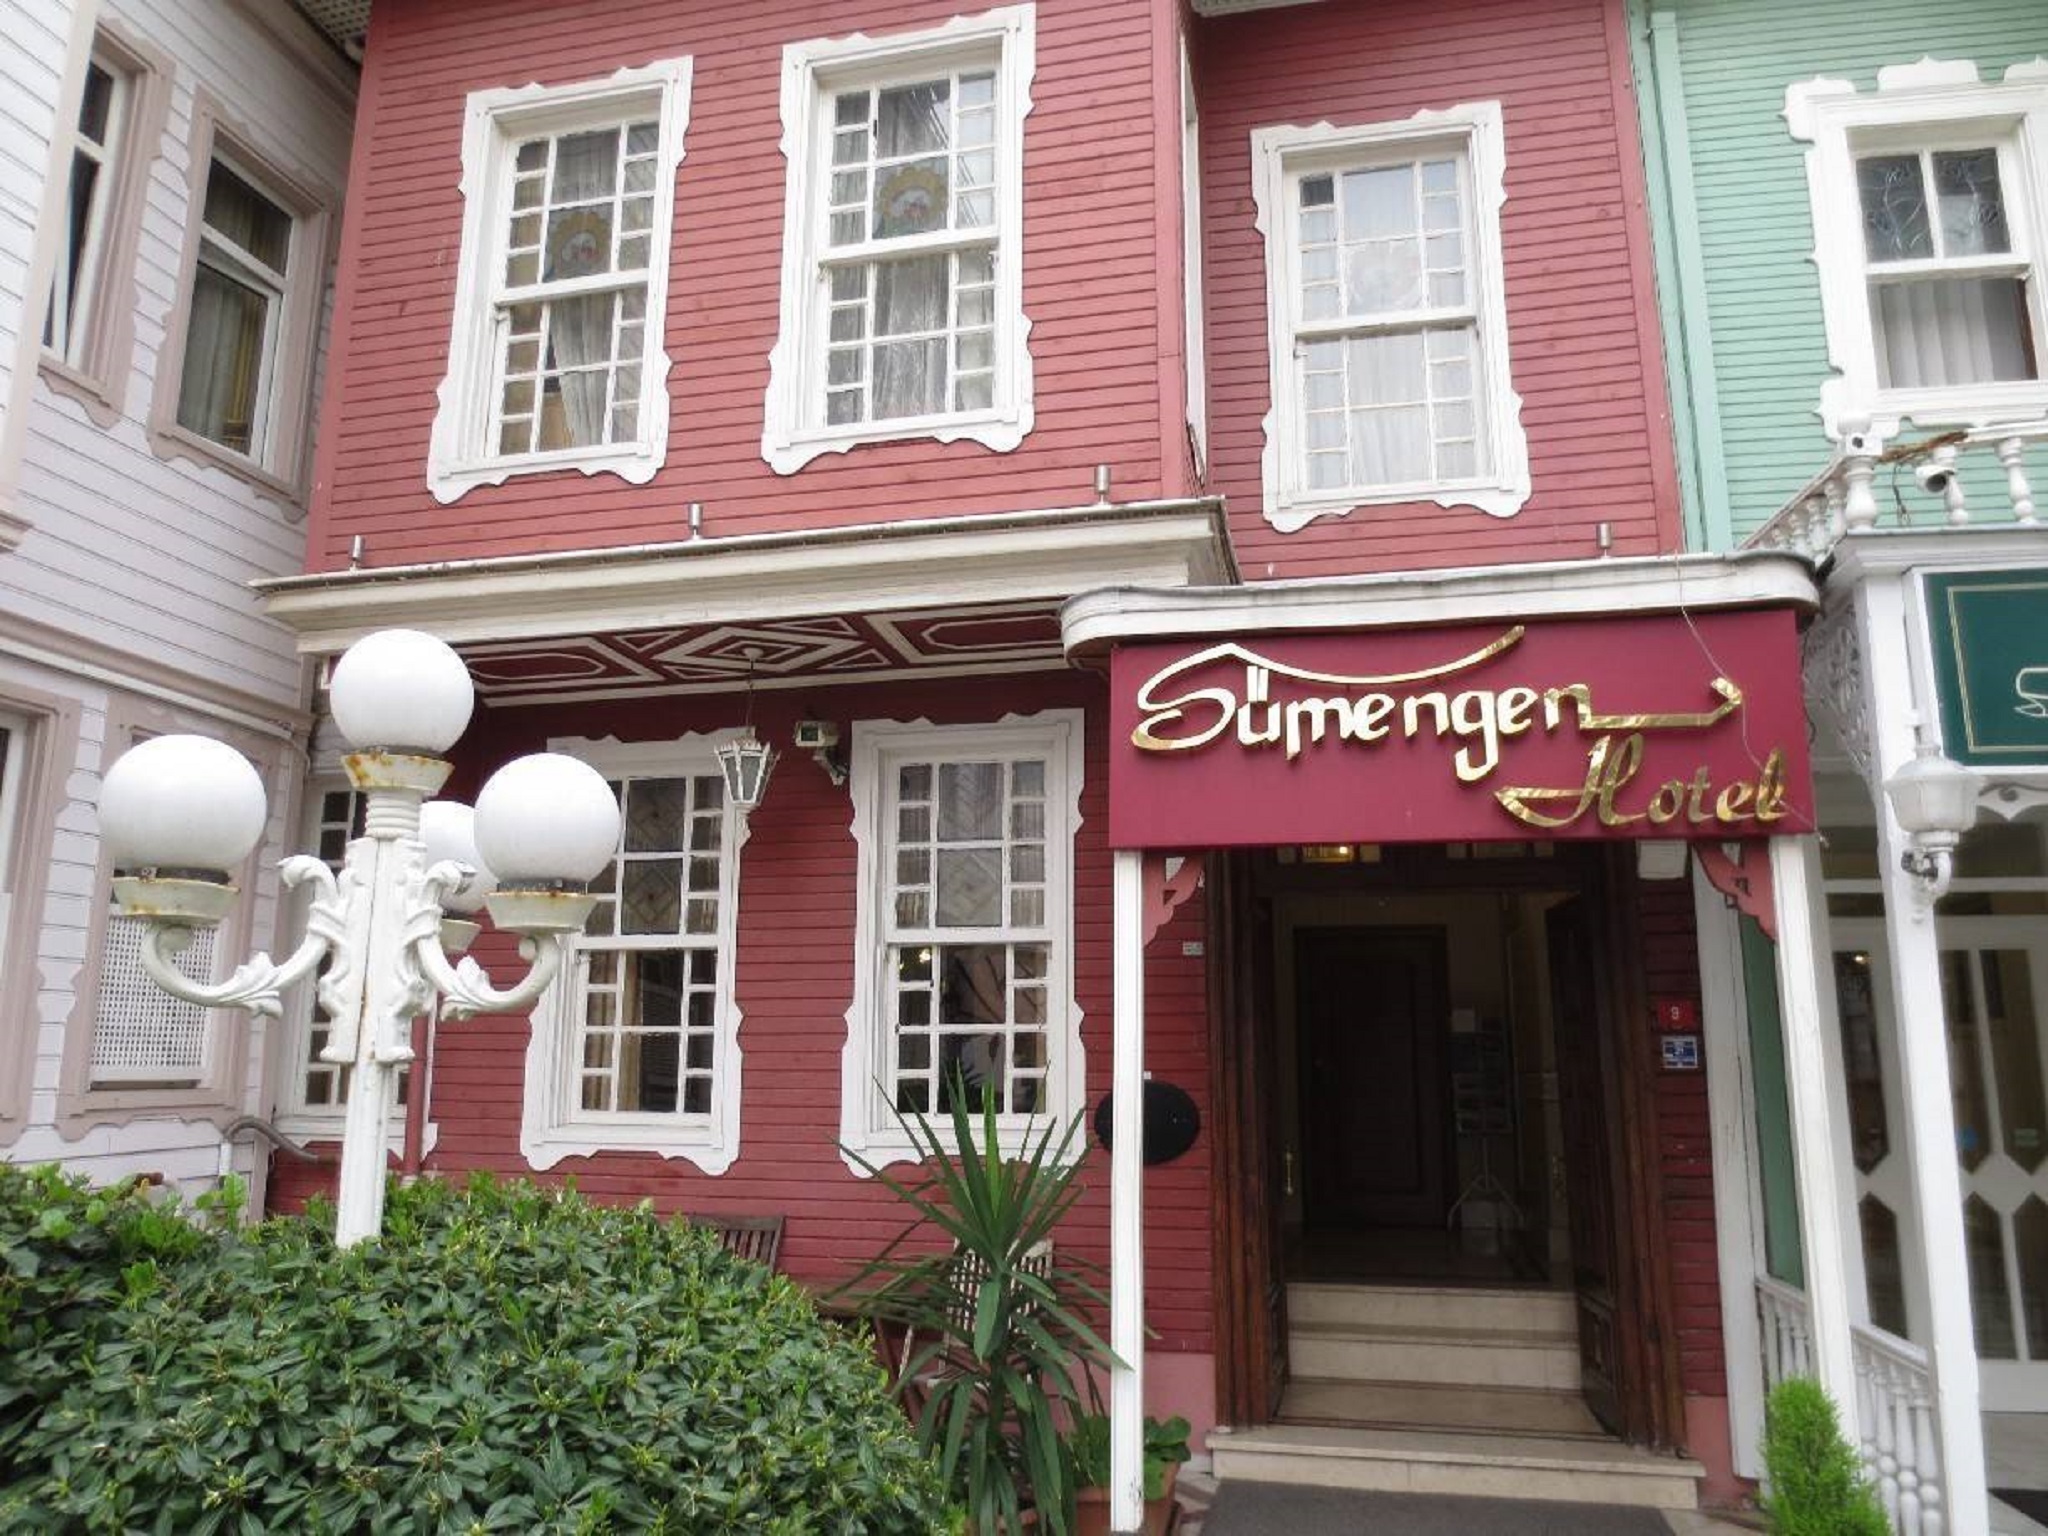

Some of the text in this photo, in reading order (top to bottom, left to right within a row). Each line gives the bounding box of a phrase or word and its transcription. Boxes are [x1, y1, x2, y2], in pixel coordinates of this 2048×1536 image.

[1131, 626, 1743, 782] Sümengen
[1493, 733, 1789, 828] Hotel
[1670, 1006, 1680, 1020] 9
